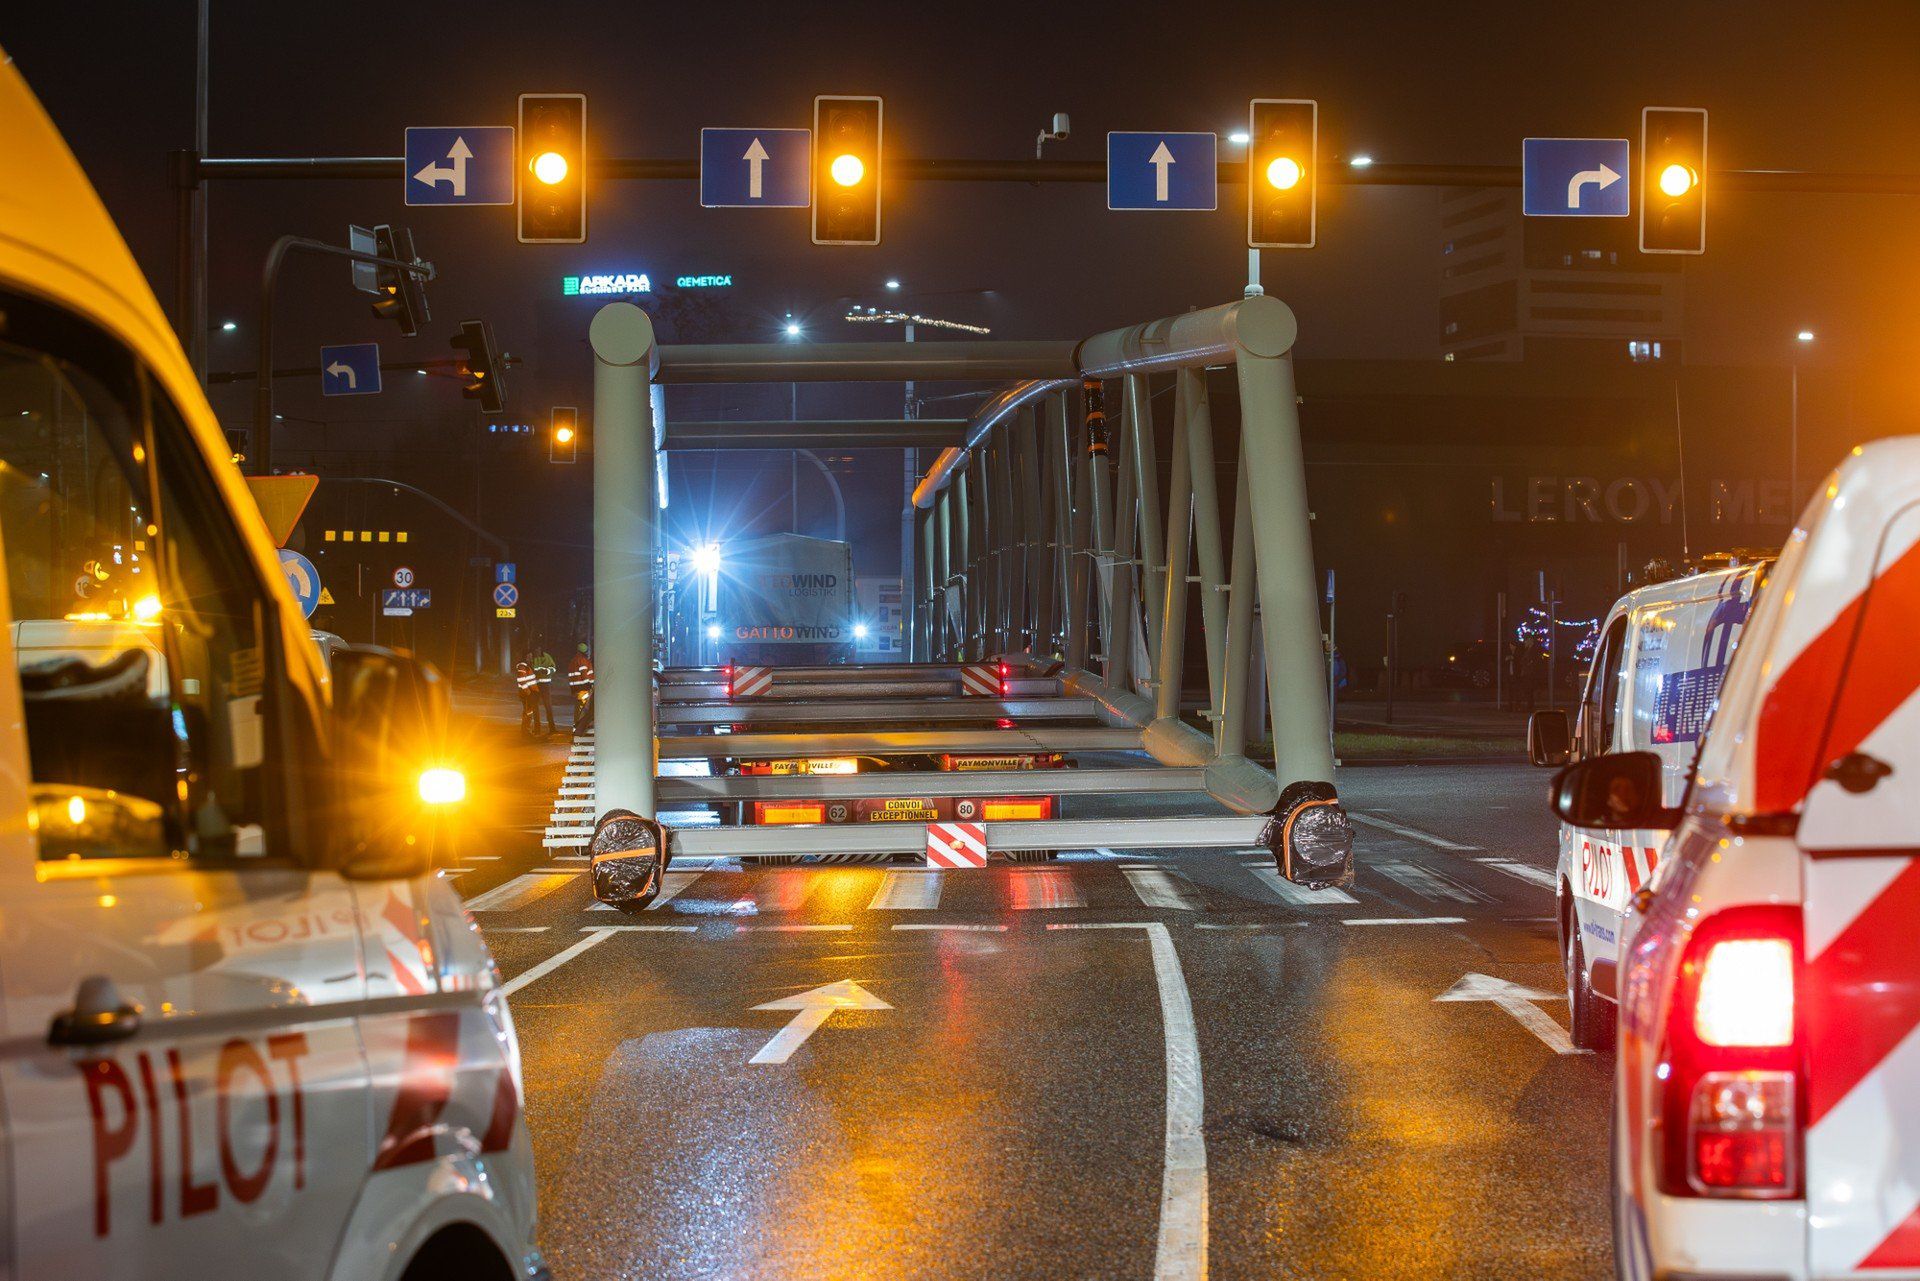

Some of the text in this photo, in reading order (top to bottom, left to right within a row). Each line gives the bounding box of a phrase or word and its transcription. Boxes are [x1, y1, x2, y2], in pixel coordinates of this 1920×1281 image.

[580, 274, 650, 287] ARKADA
[677, 276, 731, 287] QEMETICA
[1491, 475, 1681, 525] LEROY
[396, 571, 412, 584] 30
[774, 761, 833, 770] FAYMVILLE
[957, 758, 1018, 767] FAYMONVILLE
[888, 801, 920, 809] CONVOI
[959, 804, 973, 815] 80
[830, 807, 846, 818] 62
[872, 810, 935, 820] EXCEPTIONNEL
[1582, 841, 1613, 900] PILOT
[73, 1031, 310, 1239] PILOT
